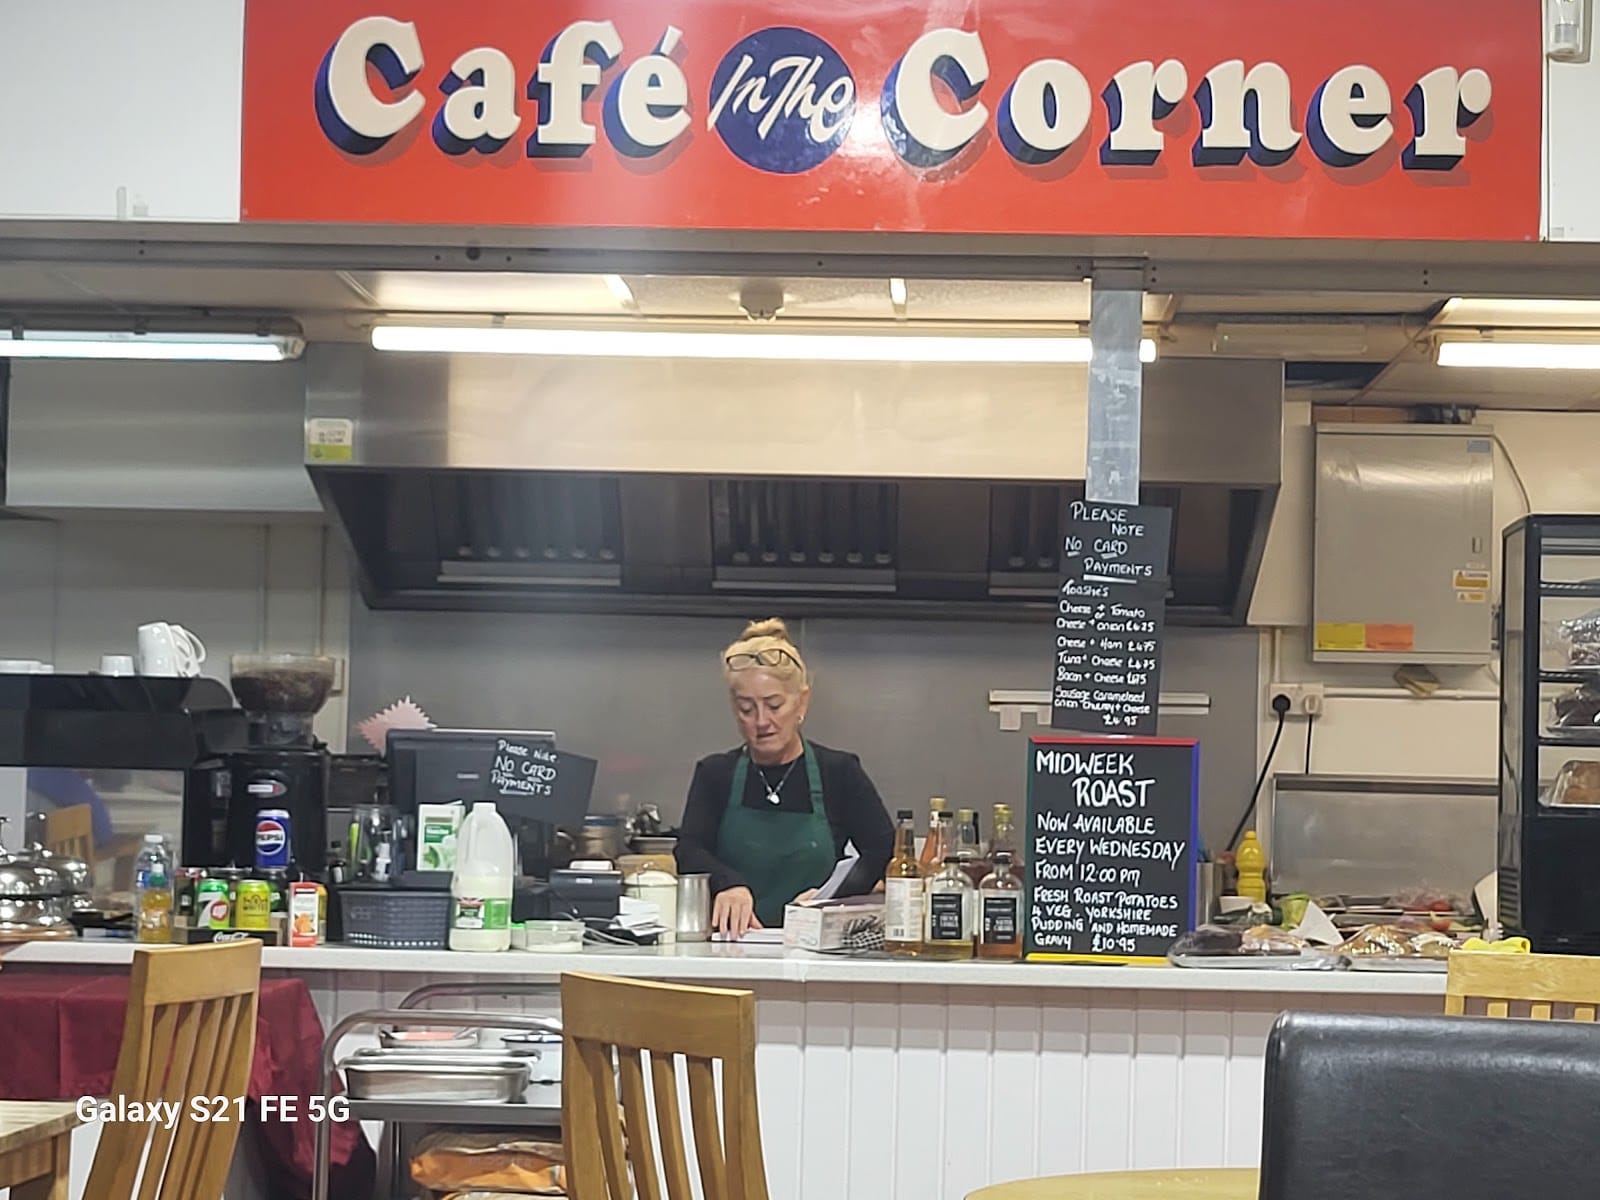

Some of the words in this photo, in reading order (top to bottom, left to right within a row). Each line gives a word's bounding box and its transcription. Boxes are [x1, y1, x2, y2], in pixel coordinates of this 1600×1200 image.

[319, 15, 693, 155] Café
[708, 54, 771, 131] In
[761, 55, 854, 144] The
[888, 27, 1493, 167] Corner
[1070, 500, 1128, 522] PLEASE
[1111, 523, 1145, 536] NOTE
[1094, 538, 1128, 555] CARD
[1084, 557, 1152, 577] PAYMENTS
[1060, 600, 1091, 614] Cheese
[1110, 603, 1145, 618] Tomato
[1056, 617, 1086, 629] Cheese
[1057, 636, 1086, 648] Cheese
[1100, 637, 1122, 650] Ham
[1058, 650, 1081, 664] Tuna
[1091, 655, 1123, 668] Cheese
[1094, 672, 1124, 684] Cheese
[1055, 685, 1090, 703] Sausage
[495, 756, 515, 772] NO
[521, 761, 556, 781] CARD
[1036, 750, 1133, 776] MIDWEEK
[491, 769, 552, 796] PAYMENTS
[1072, 776, 1155, 808] ROAST
[1037, 811, 1070, 832] NOW
[1073, 813, 1155, 834] AVAILABLE
[1035, 836, 1085, 864] EVERY
[1090, 837, 1185, 871] WEDNESDAY
[1035, 859, 1073, 881] FROM
[1034, 885, 1068, 902] FRESH
[1074, 887, 1114, 904] ROAST
[1115, 891, 1178, 909] POTATOES
[1085, 906, 1152, 923] YORKSHIRE
[1031, 917, 1083, 932] PUDDING
[1091, 924, 1113, 934] AND
[1117, 922, 1178, 936] HOMEMADE
[1034, 932, 1072, 950] GRAVY
